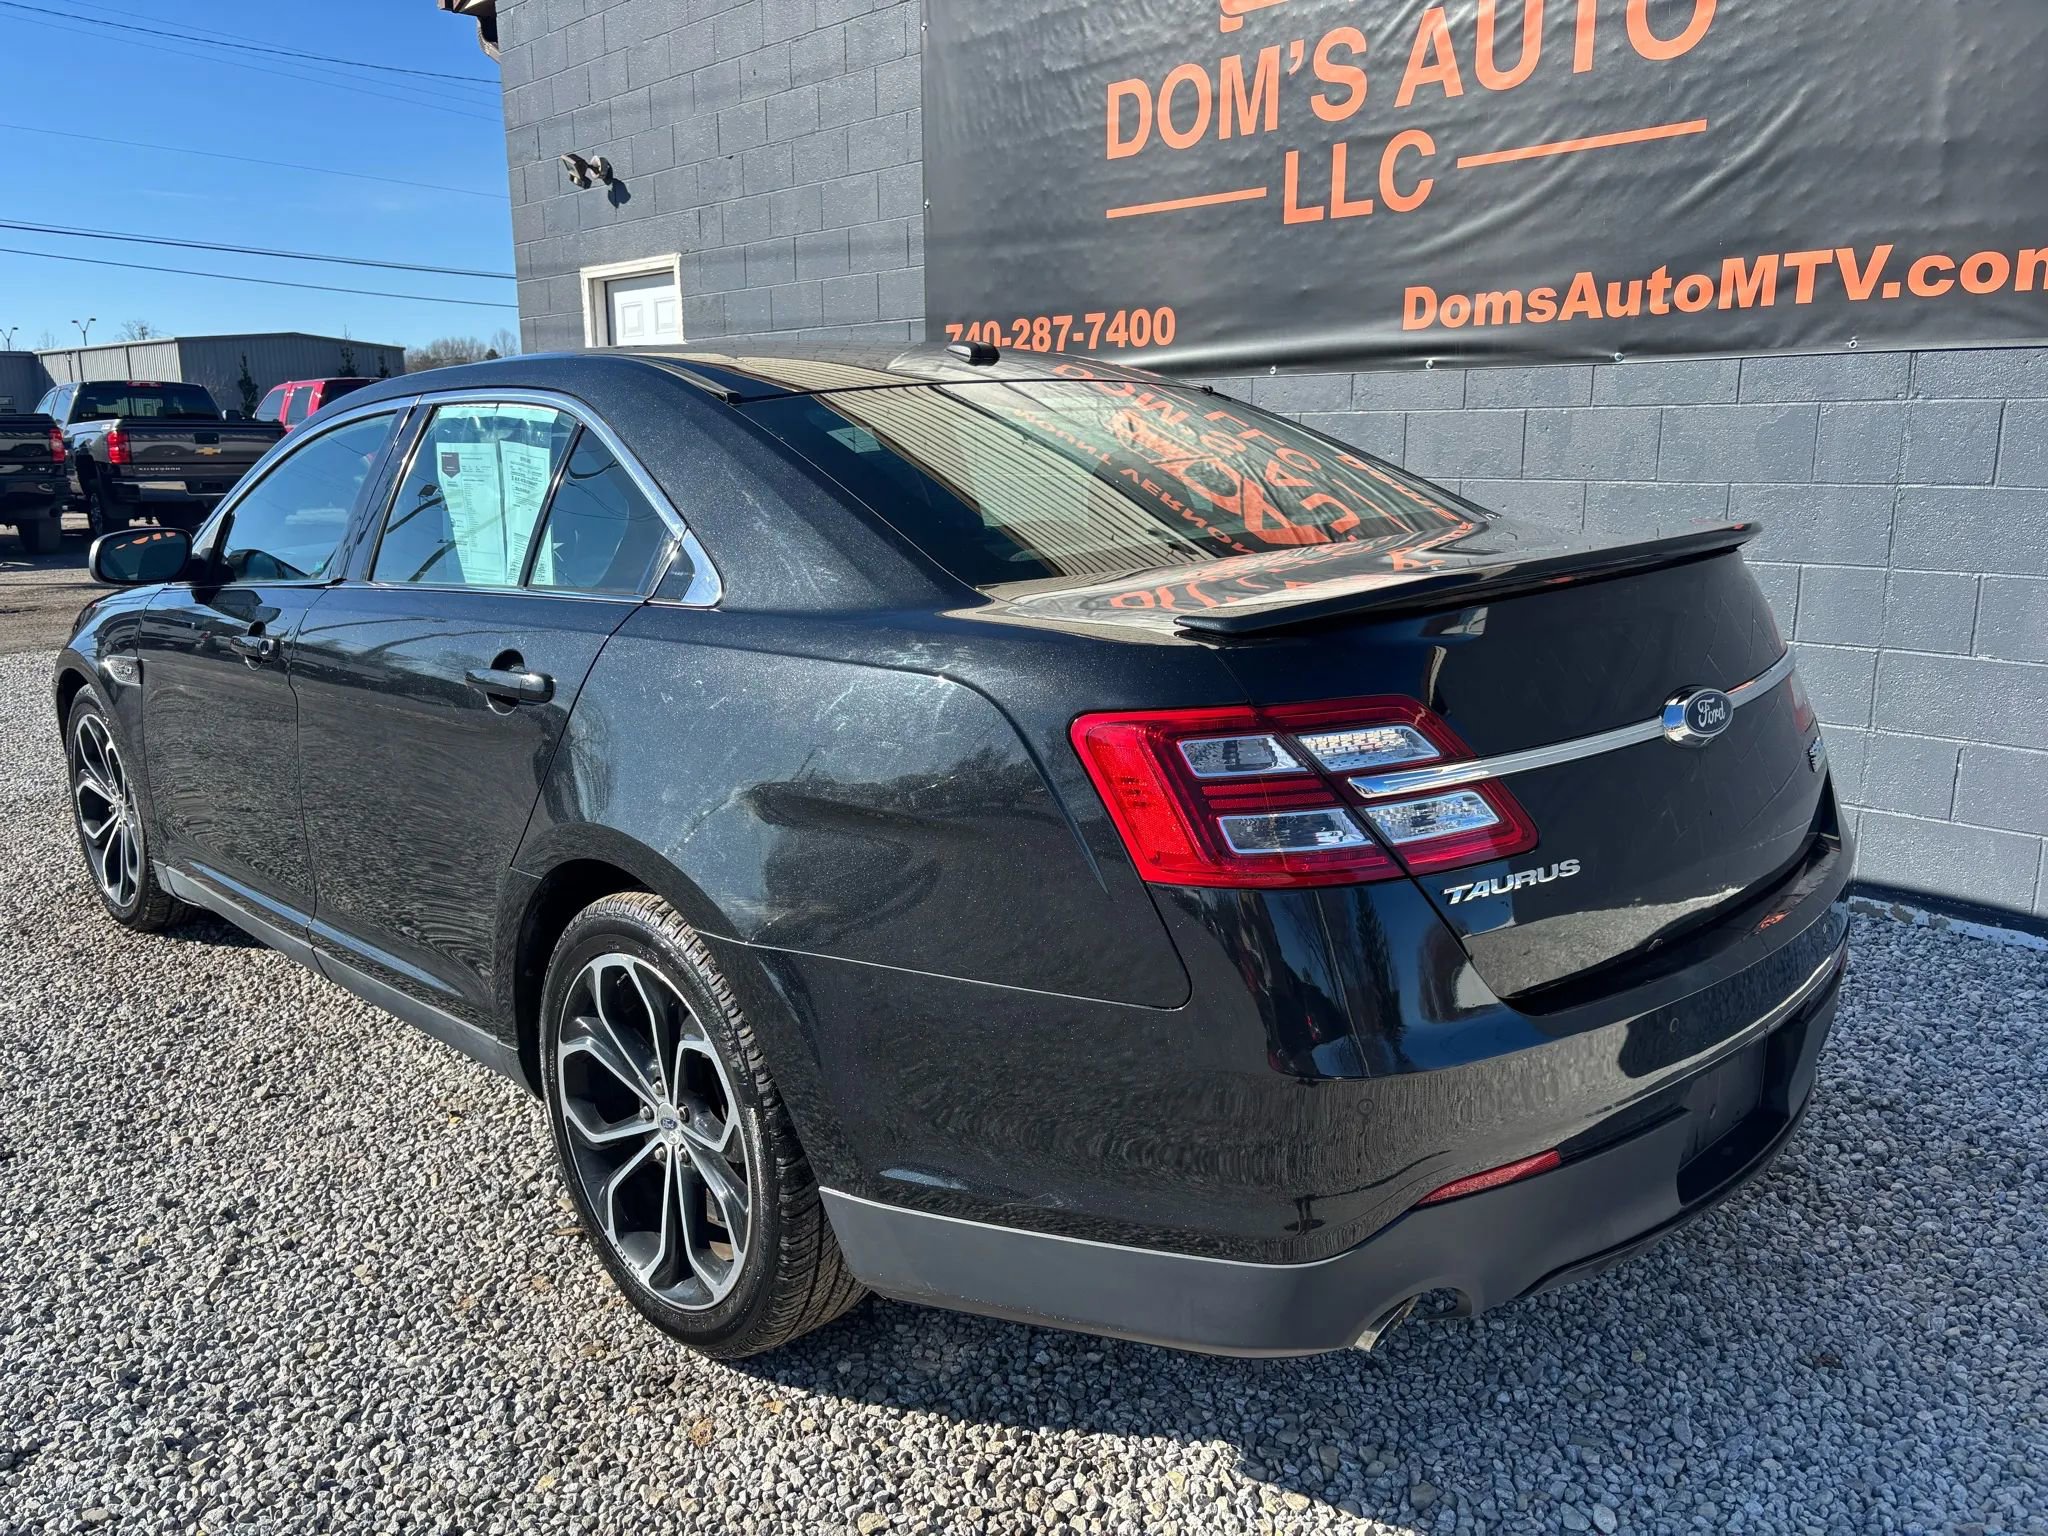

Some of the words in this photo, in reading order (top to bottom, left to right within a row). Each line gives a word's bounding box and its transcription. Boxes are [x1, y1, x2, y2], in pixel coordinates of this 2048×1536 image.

[1106, 26, 1368, 160] DOM'S
[1283, 130, 1436, 225] LLC
[945, 306, 1176, 353] 740-287-7400
[1697, 697, 1726, 728] Ford
[1443, 858, 1581, 905] TAURUS
